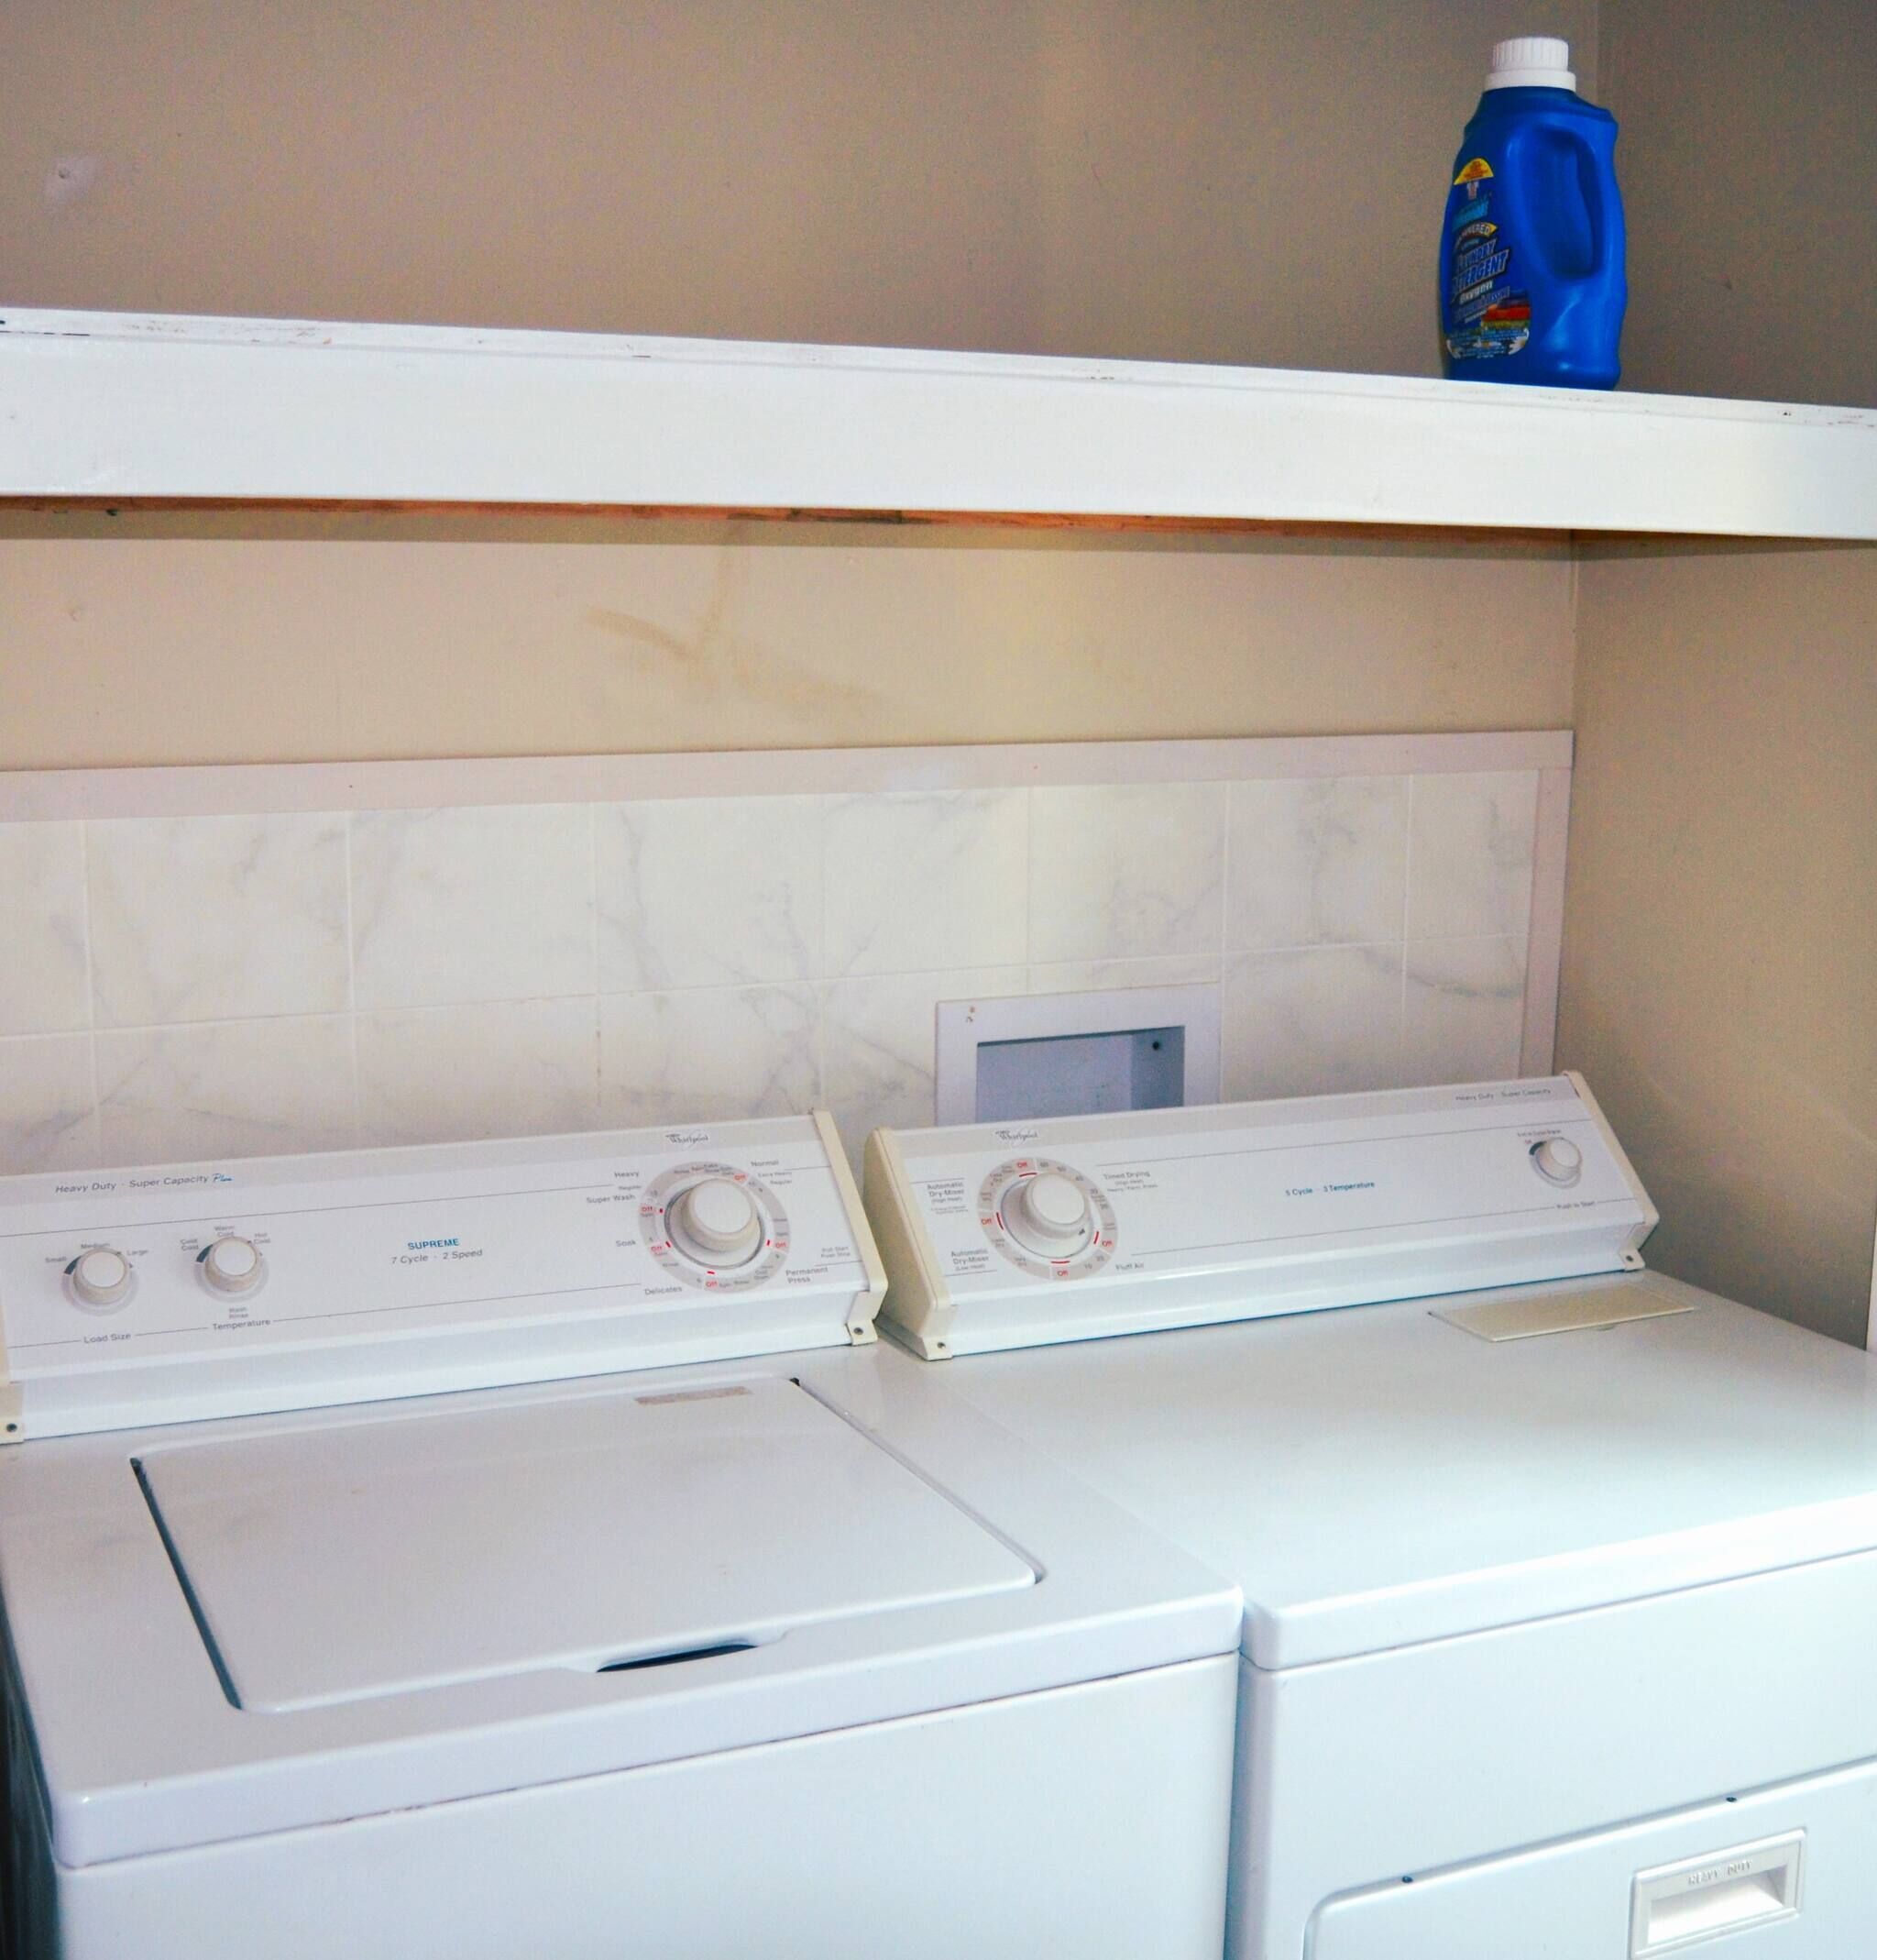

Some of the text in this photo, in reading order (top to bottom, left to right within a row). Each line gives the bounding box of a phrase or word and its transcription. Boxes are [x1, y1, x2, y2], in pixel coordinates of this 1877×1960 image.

[1477, 1093, 1495, 1101] Duty
[1501, 1090, 1521, 1098] Super
[1522, 1087, 1552, 1097] Capacity
[665, 1131, 709, 1146] Whirlpool
[996, 1129, 1039, 1144] Whirlpool
[751, 1160, 779, 1168] Normal
[1016, 1161, 1028, 1169] Off
[614, 1171, 640, 1180] Heavy
[1125, 1171, 1151, 1181] Drying
[54, 1183, 89, 1194] Heavy
[92, 1181, 117, 1192] Duty
[128, 1178, 160, 1190] Super
[162, 1174, 209, 1186] Capacity
[927, 1181, 964, 1190] Automatic
[1291, 1187, 1313, 1196] Cycle
[1329, 1182, 1375, 1191] Temperature
[586, 1194, 636, 1206] Super Wash
[981, 1217, 993, 1226] Off
[80, 1241, 111, 1250] Medium
[181, 1243, 200, 1251] Cold
[407, 1238, 460, 1250] SUPREME
[615, 1239, 636, 1248] Soak
[126, 1248, 149, 1257] Large
[399, 1254, 429, 1265] Cycle
[442, 1251, 449, 1261] 2
[451, 1249, 483, 1261] Speed
[951, 1248, 989, 1257] Automatic
[44, 1256, 68, 1264] Small
[785, 1266, 829, 1277] Permanent
[787, 1276, 811, 1284] Press
[644, 1285, 683, 1295] Delicates
[212, 1319, 270, 1330] Temperature
[83, 1332, 132, 1344] Load Size
